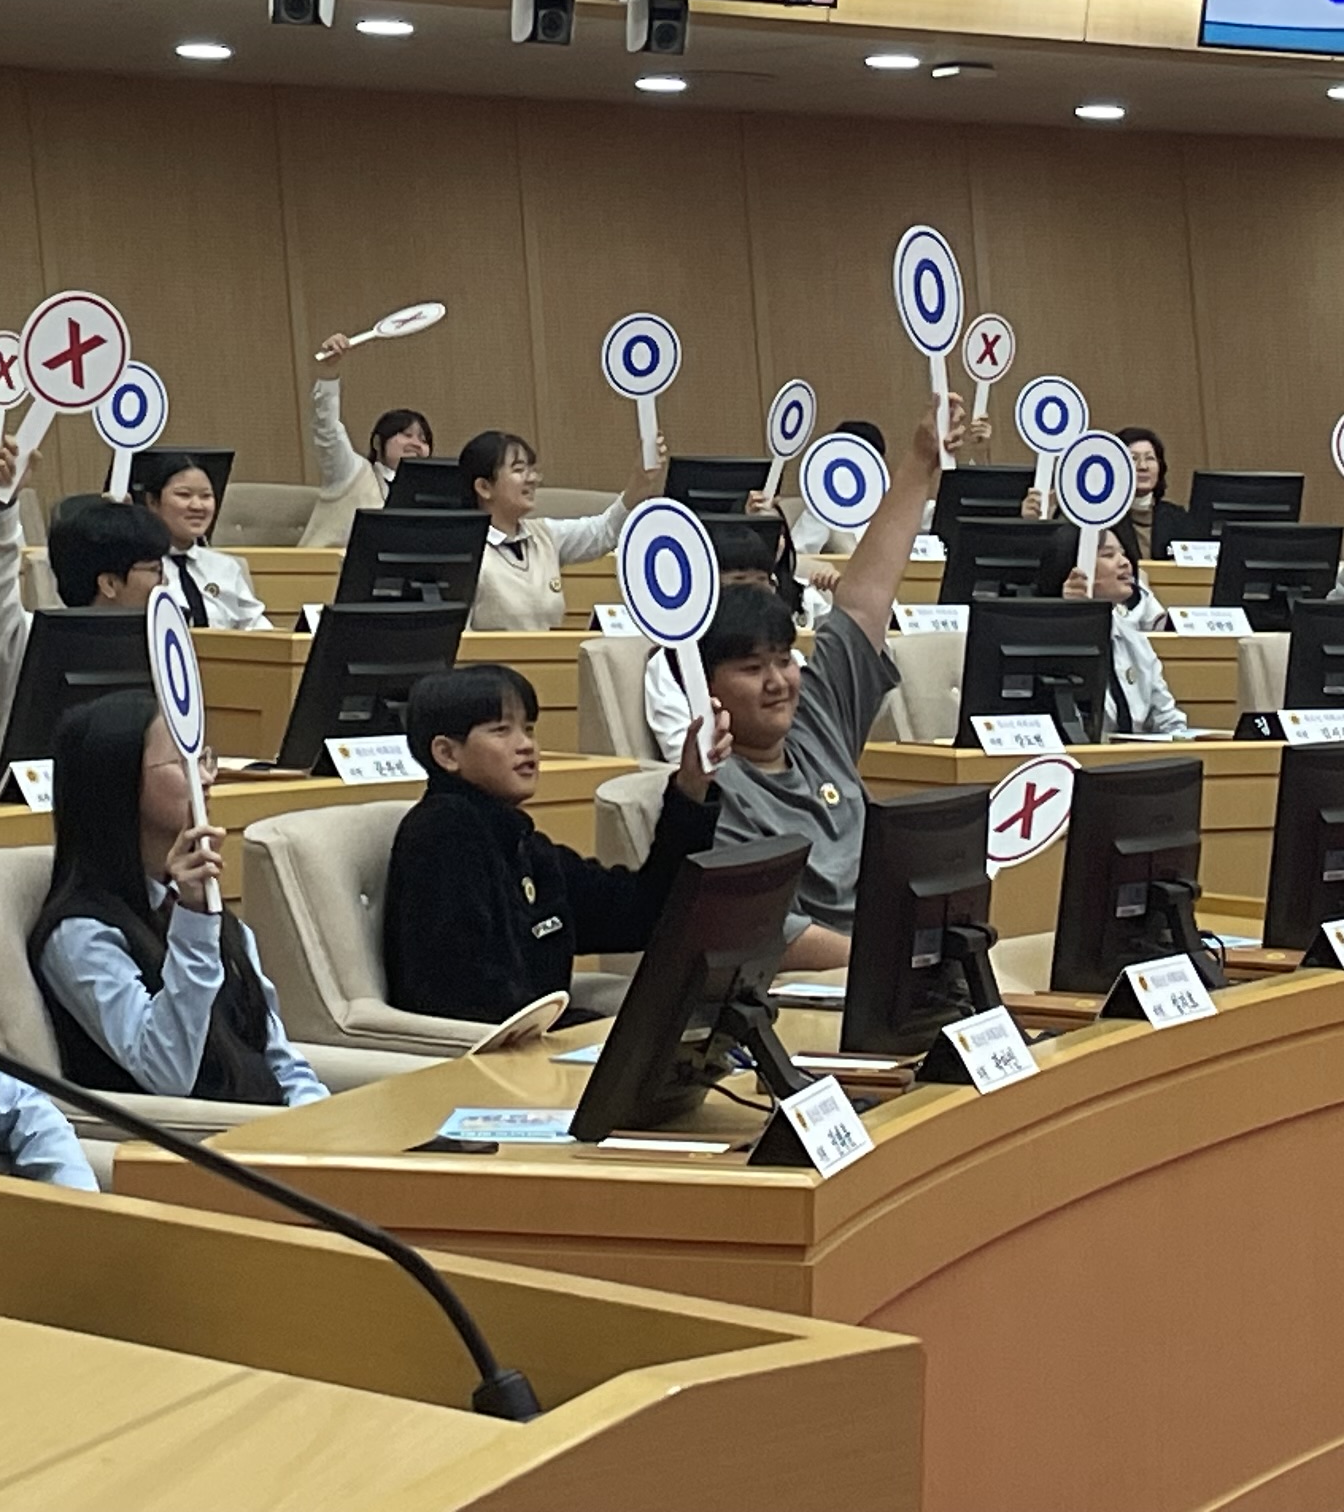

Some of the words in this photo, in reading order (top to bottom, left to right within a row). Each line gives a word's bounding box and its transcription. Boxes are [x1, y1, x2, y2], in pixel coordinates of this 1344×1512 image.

[914, 258, 946, 324] O
[43, 318, 106, 389] X
[622, 334, 660, 377] O
[976, 333, 1001, 365] X
[112, 383, 147, 428] O
[780, 400, 804, 440] O
[1034, 395, 1069, 436] O
[822, 457, 868, 507] O
[1077, 454, 1115, 504] O
[644, 536, 692, 610] O
[164, 628, 191, 717] O
[994, 781, 1060, 839] X
